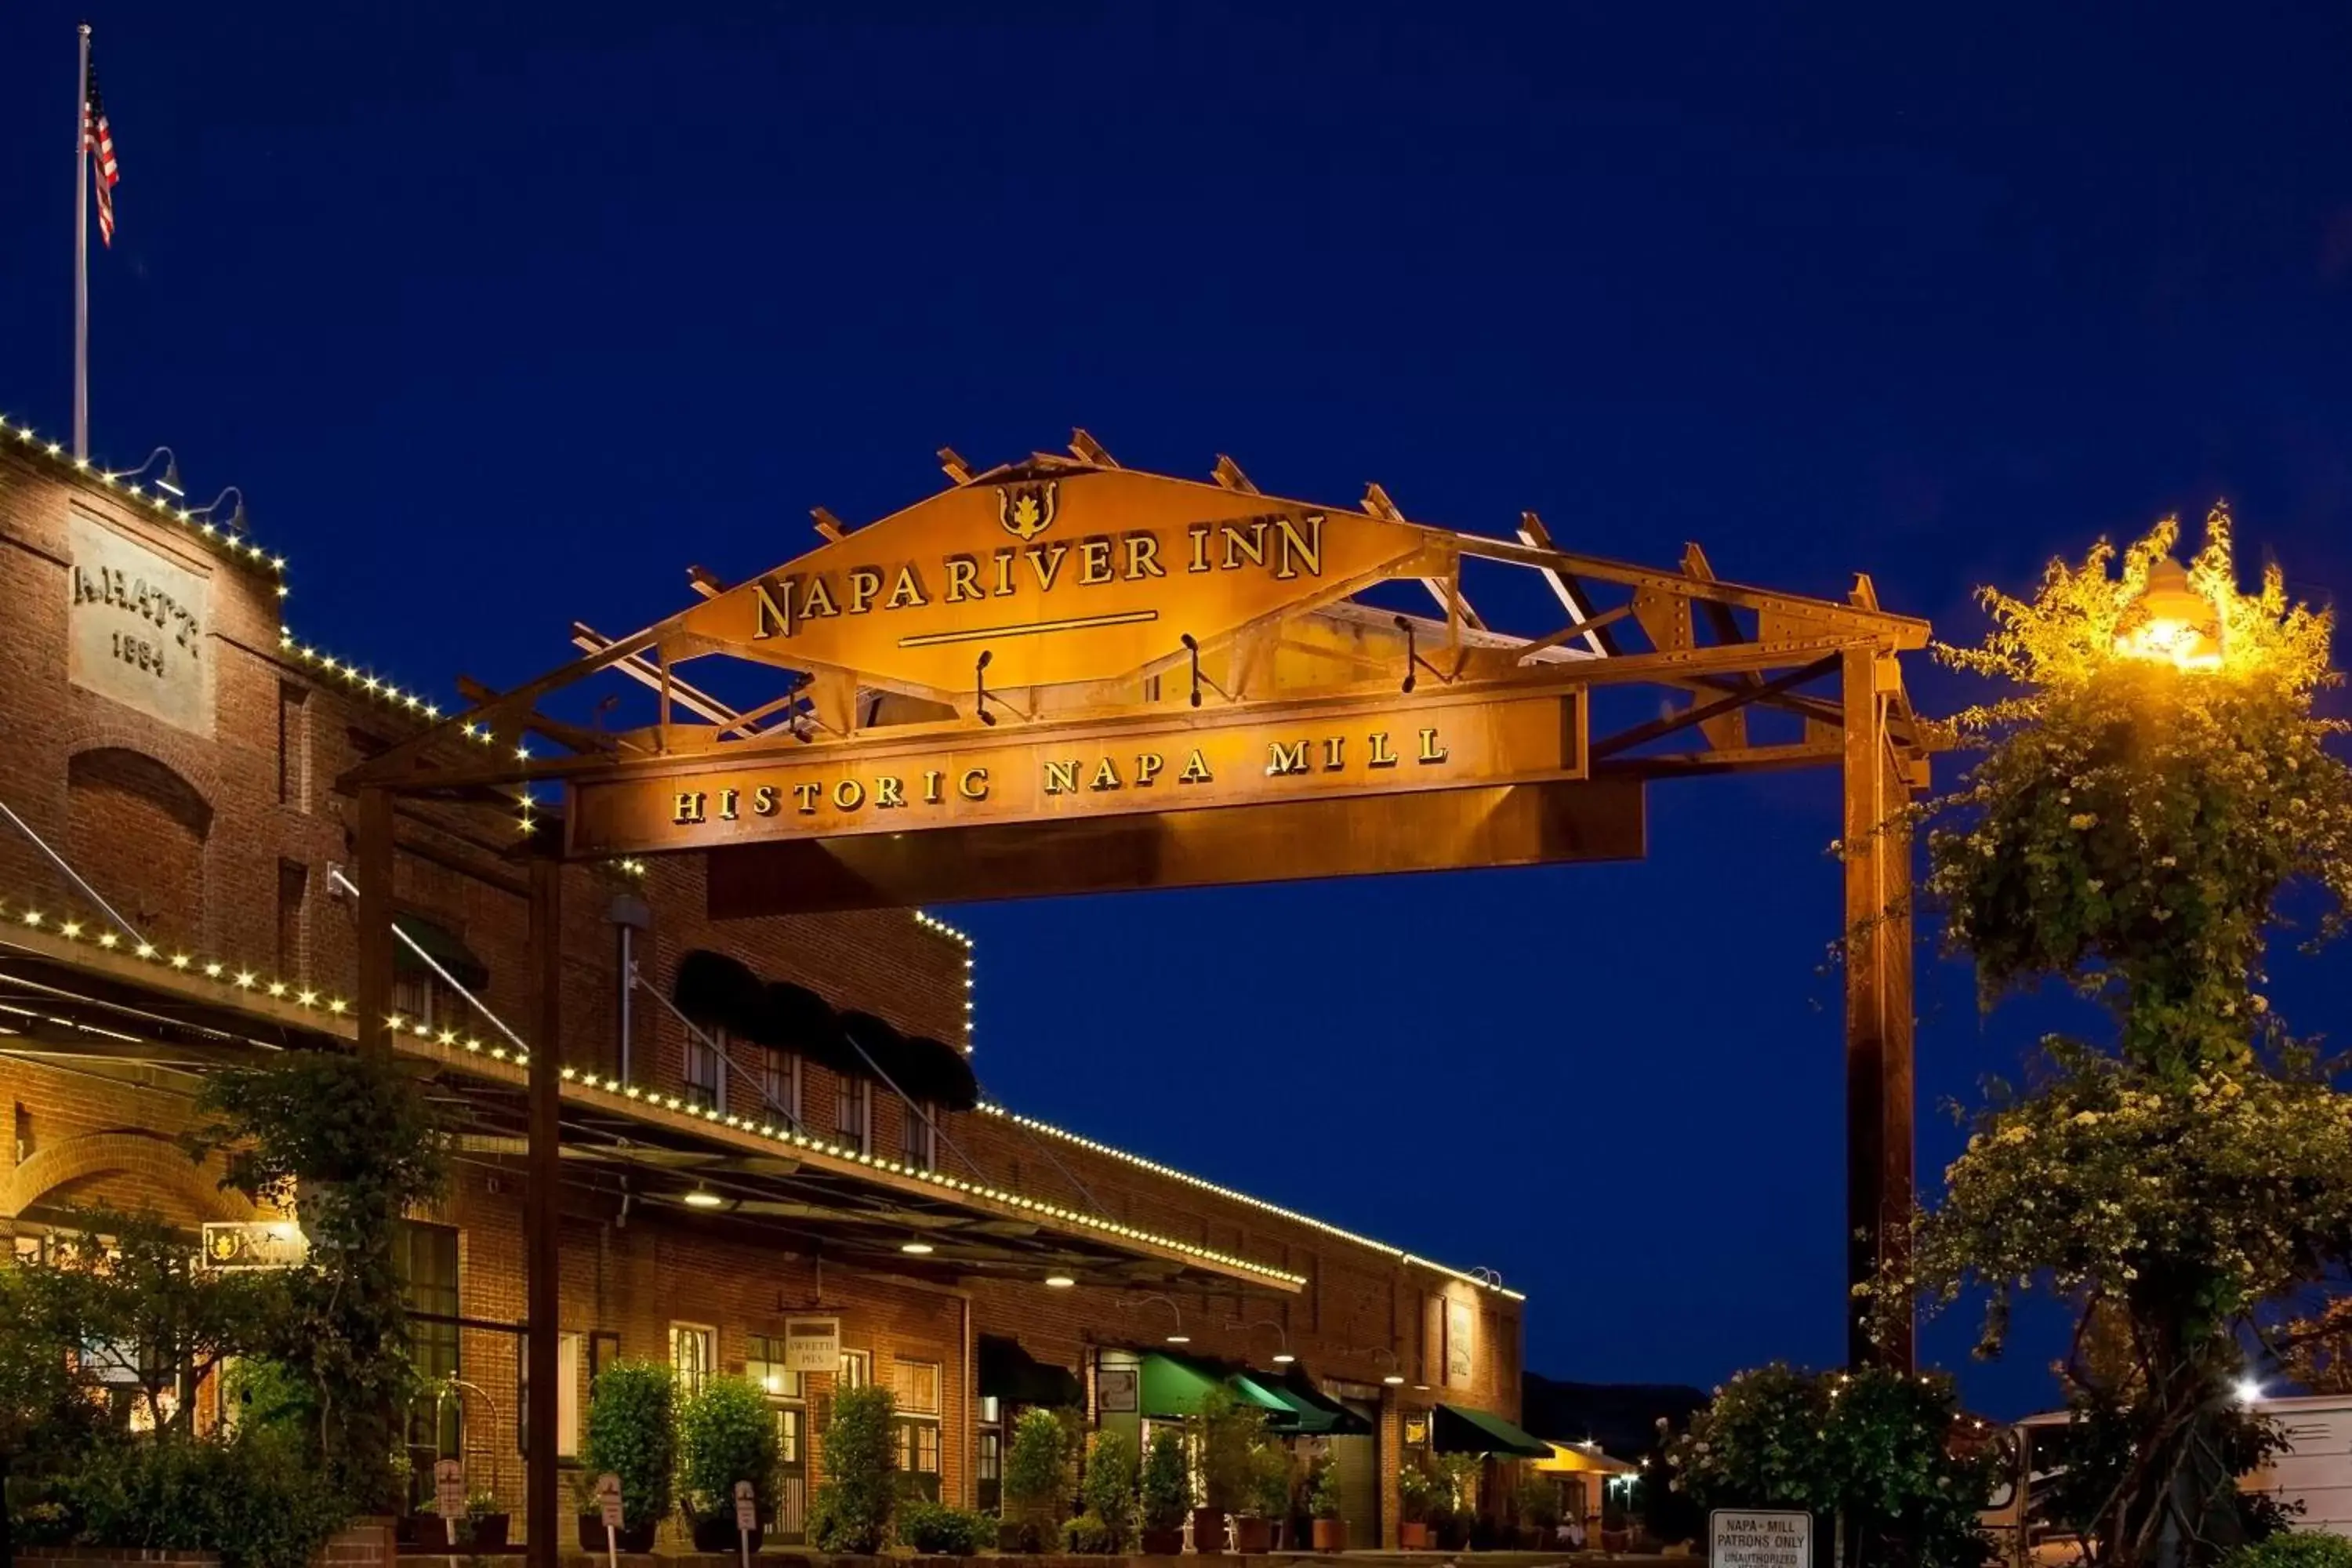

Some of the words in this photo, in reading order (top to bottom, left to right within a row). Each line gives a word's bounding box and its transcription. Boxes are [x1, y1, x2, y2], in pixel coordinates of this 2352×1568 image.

[752, 564, 928, 640] NAPA
[945, 536, 1166, 603] RIVER
[1189, 515, 1326, 579] INN
[112, 630, 164, 677] 1884
[673, 768, 989, 824] HISTORIC
[1044, 748, 1213, 795] NAPA
[1266, 728, 1448, 775] MILL
[1717, 1534, 1770, 1549] PATRONS
[1774, 1536, 1805, 1549] ONLY
[1726, 1519, 1758, 1533] NAPA
[1767, 1520, 1795, 1534] MILL
[1724, 1552, 1798, 1564] UNAUTHORIZED
